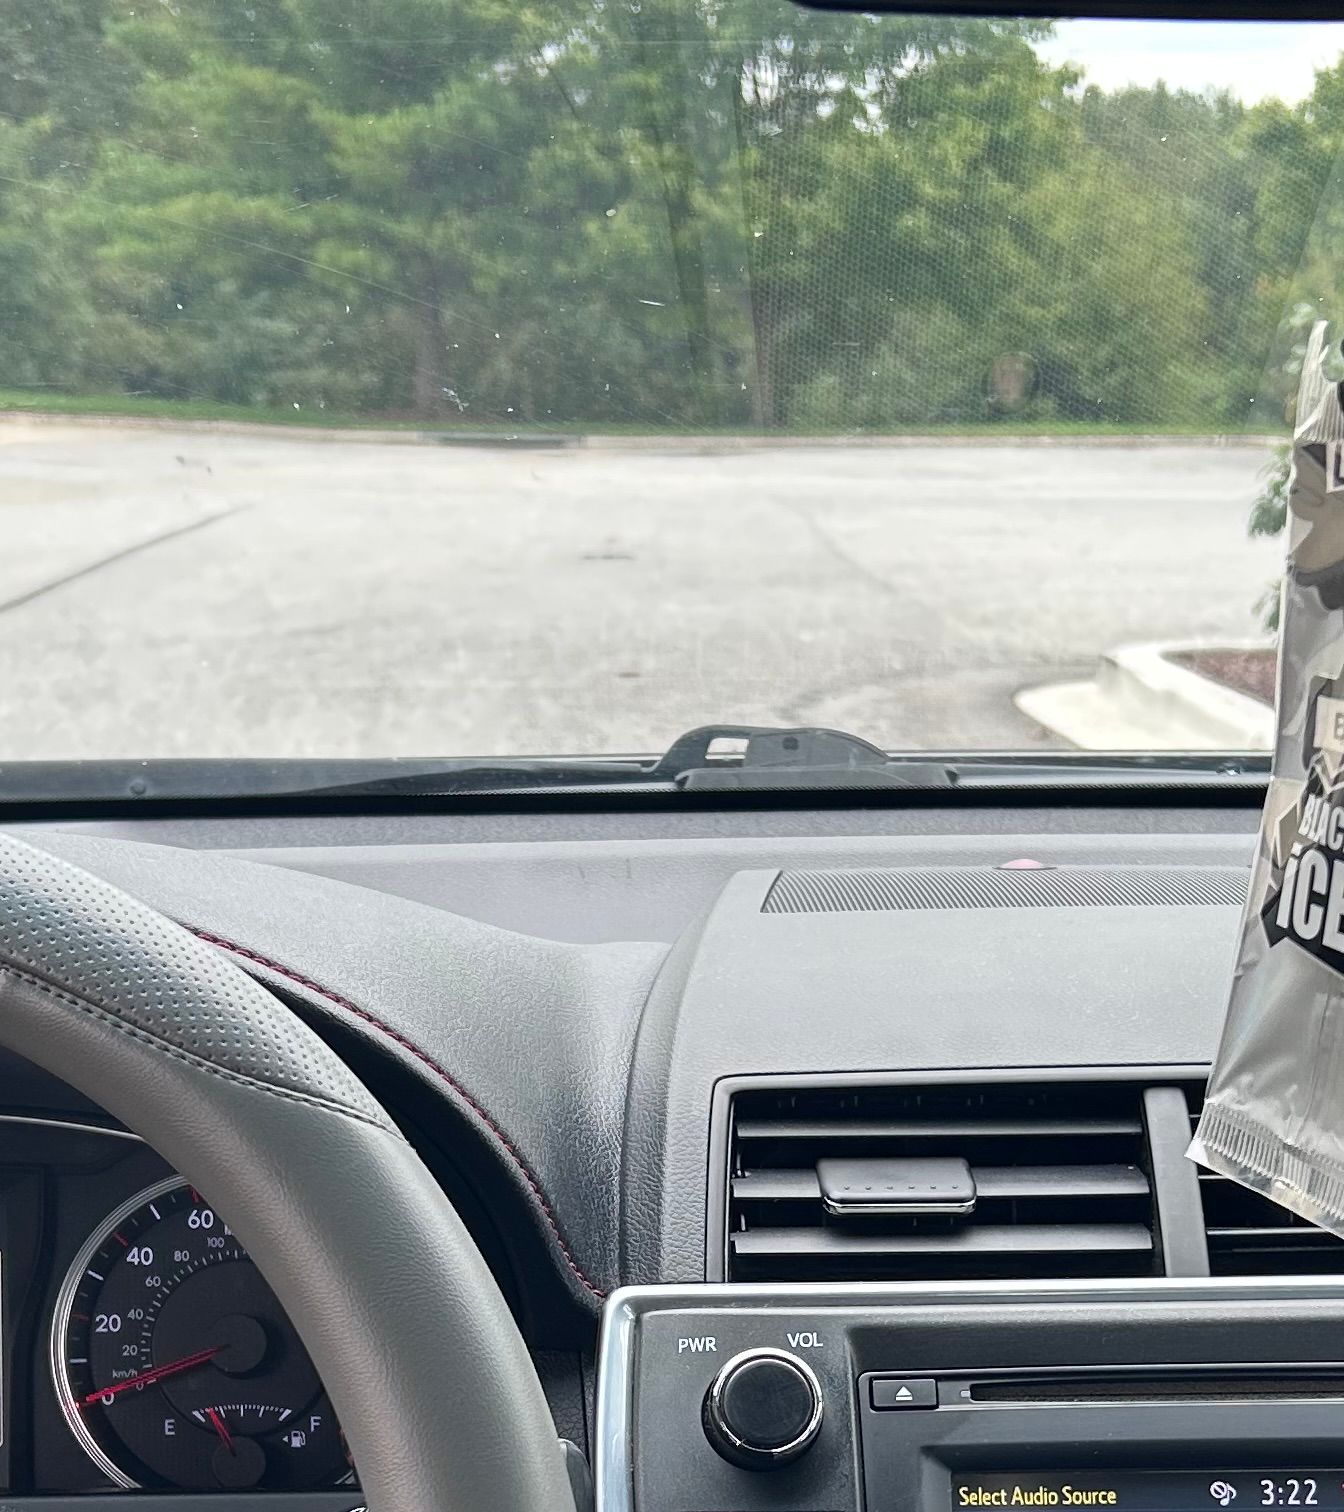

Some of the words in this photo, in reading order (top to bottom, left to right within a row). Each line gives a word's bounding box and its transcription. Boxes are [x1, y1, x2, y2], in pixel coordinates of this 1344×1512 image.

[187, 1209, 214, 1230] 60
[207, 1236, 225, 1249] 100
[126, 1246, 154, 1266] 40
[174, 1250, 190, 1262] 80
[145, 1276, 162, 1288] 60
[127, 1308, 144, 1321] 40
[95, 1314, 122, 1333] 20
[677, 1336, 718, 1355] PWR
[787, 1332, 824, 1349] VOL
[122, 1344, 138, 1357] 20
[112, 1368, 138, 1379] km/h
[164, 1419, 176, 1436] E
[310, 1416, 322, 1433] F
[959, 1486, 1007, 1506] Select
[1010, 1485, 1059, 1506] Audio
[1061, 1485, 1117, 1505] Source
[1260, 1478, 1318, 1507] 3:22
